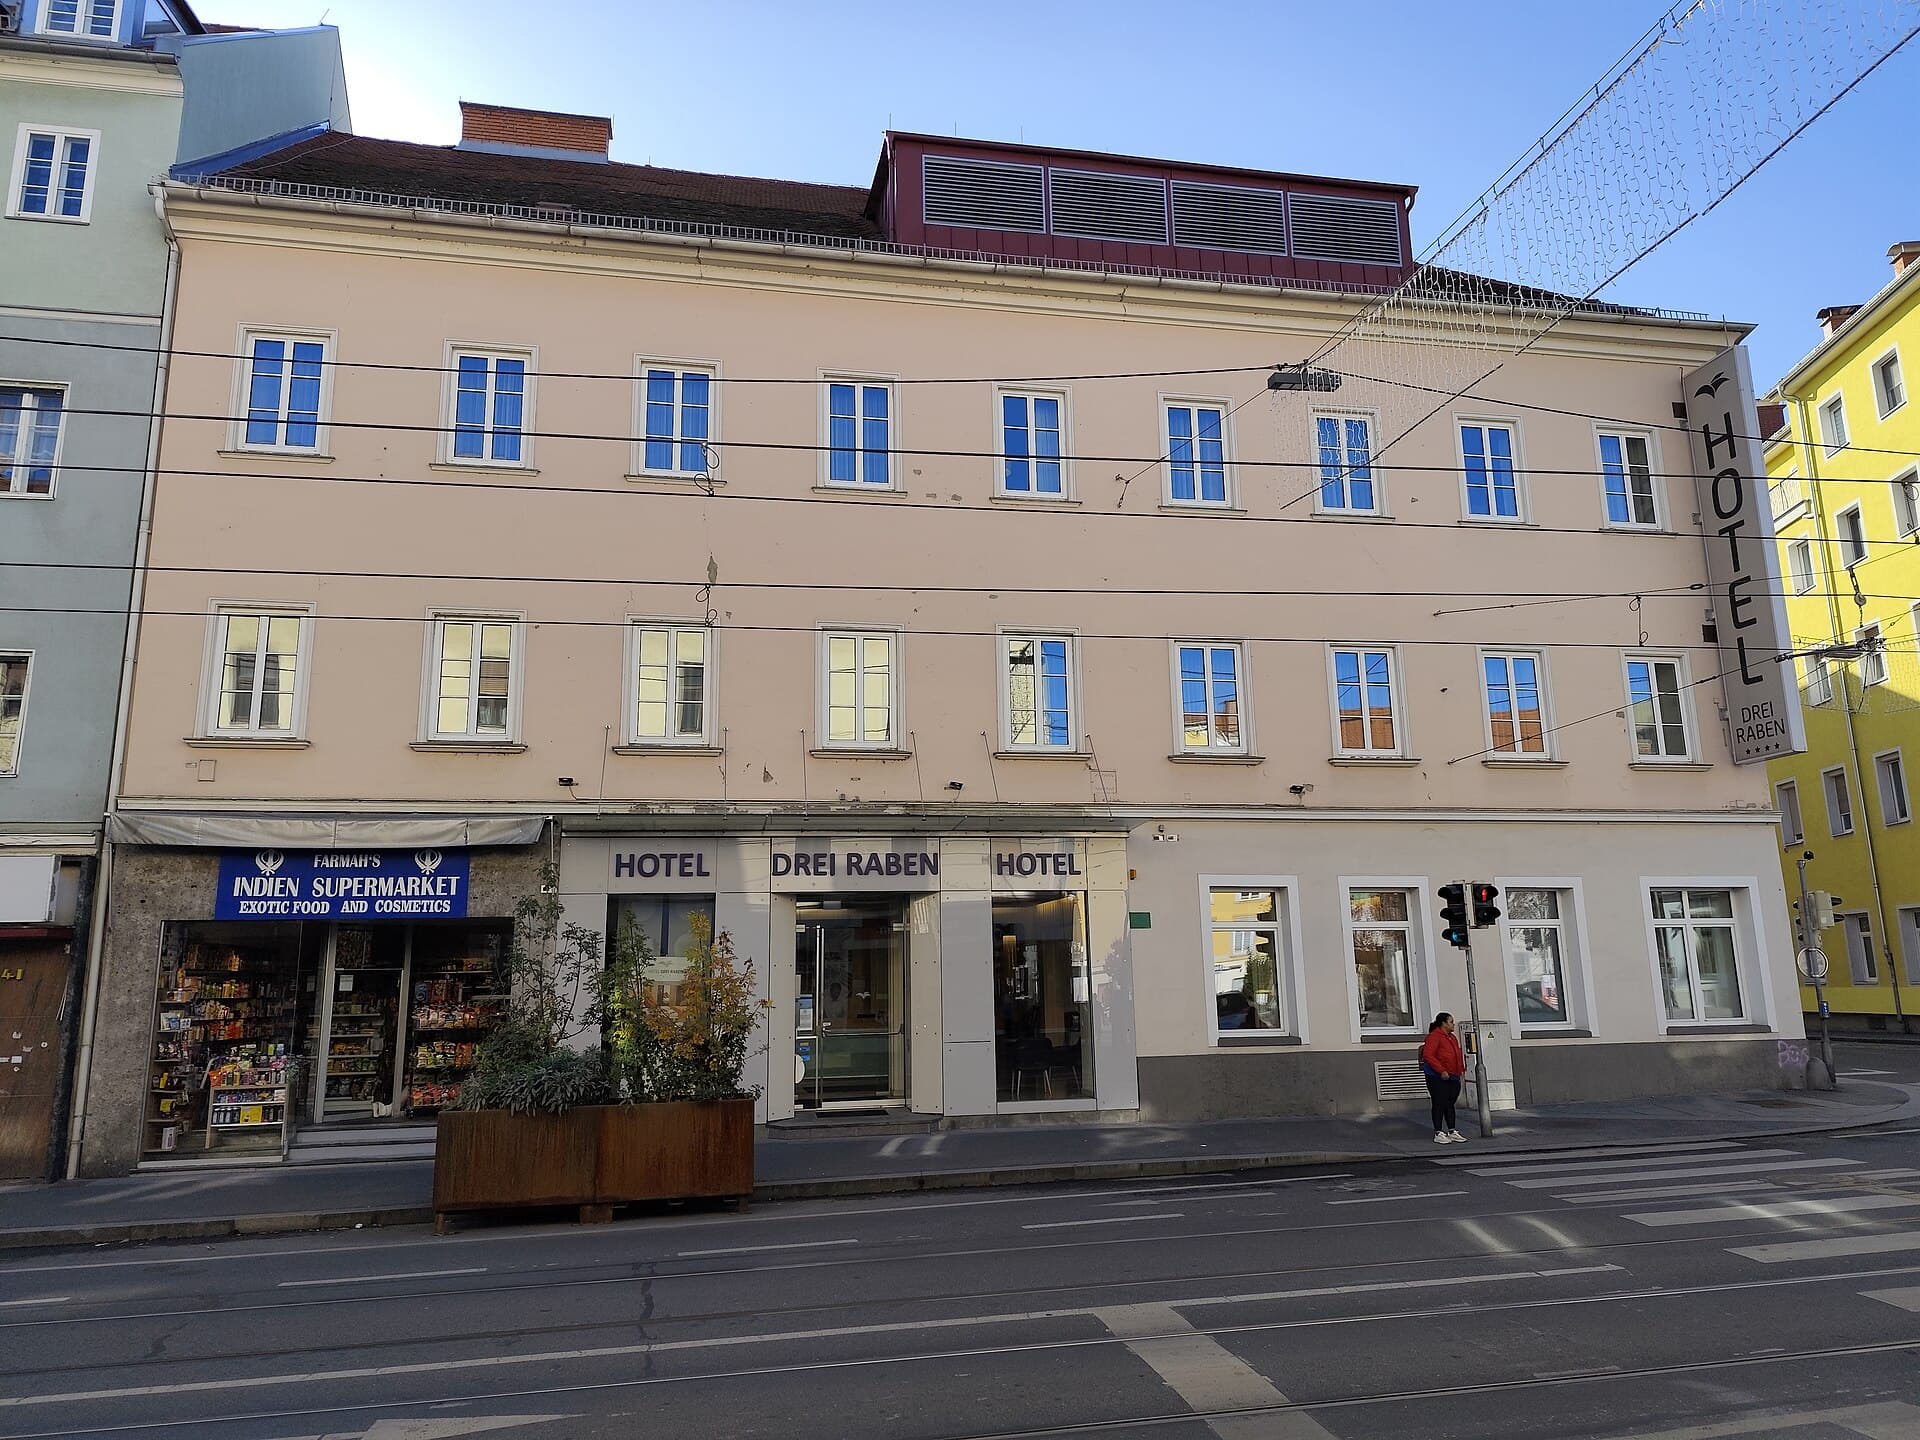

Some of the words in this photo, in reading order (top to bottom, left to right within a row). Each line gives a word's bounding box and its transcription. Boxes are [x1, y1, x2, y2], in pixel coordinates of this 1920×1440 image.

[1702, 411, 1763, 686] HOTEL
[1741, 701, 1774, 723] DREI
[1736, 718, 1786, 744] RABEN
[614, 853, 710, 878] HOTEL
[771, 852, 836, 876] DREI
[846, 852, 939, 876] RABEN
[996, 853, 1081, 876] HOTEL
[233, 876, 300, 897] INDIEN
[312, 876, 461, 898] SUPERMARKET
[238, 900, 290, 914] EXOTIC
[291, 900, 330, 914] FOOD
[340, 900, 369, 913] AND
[375, 899, 451, 913] COSMETICS
